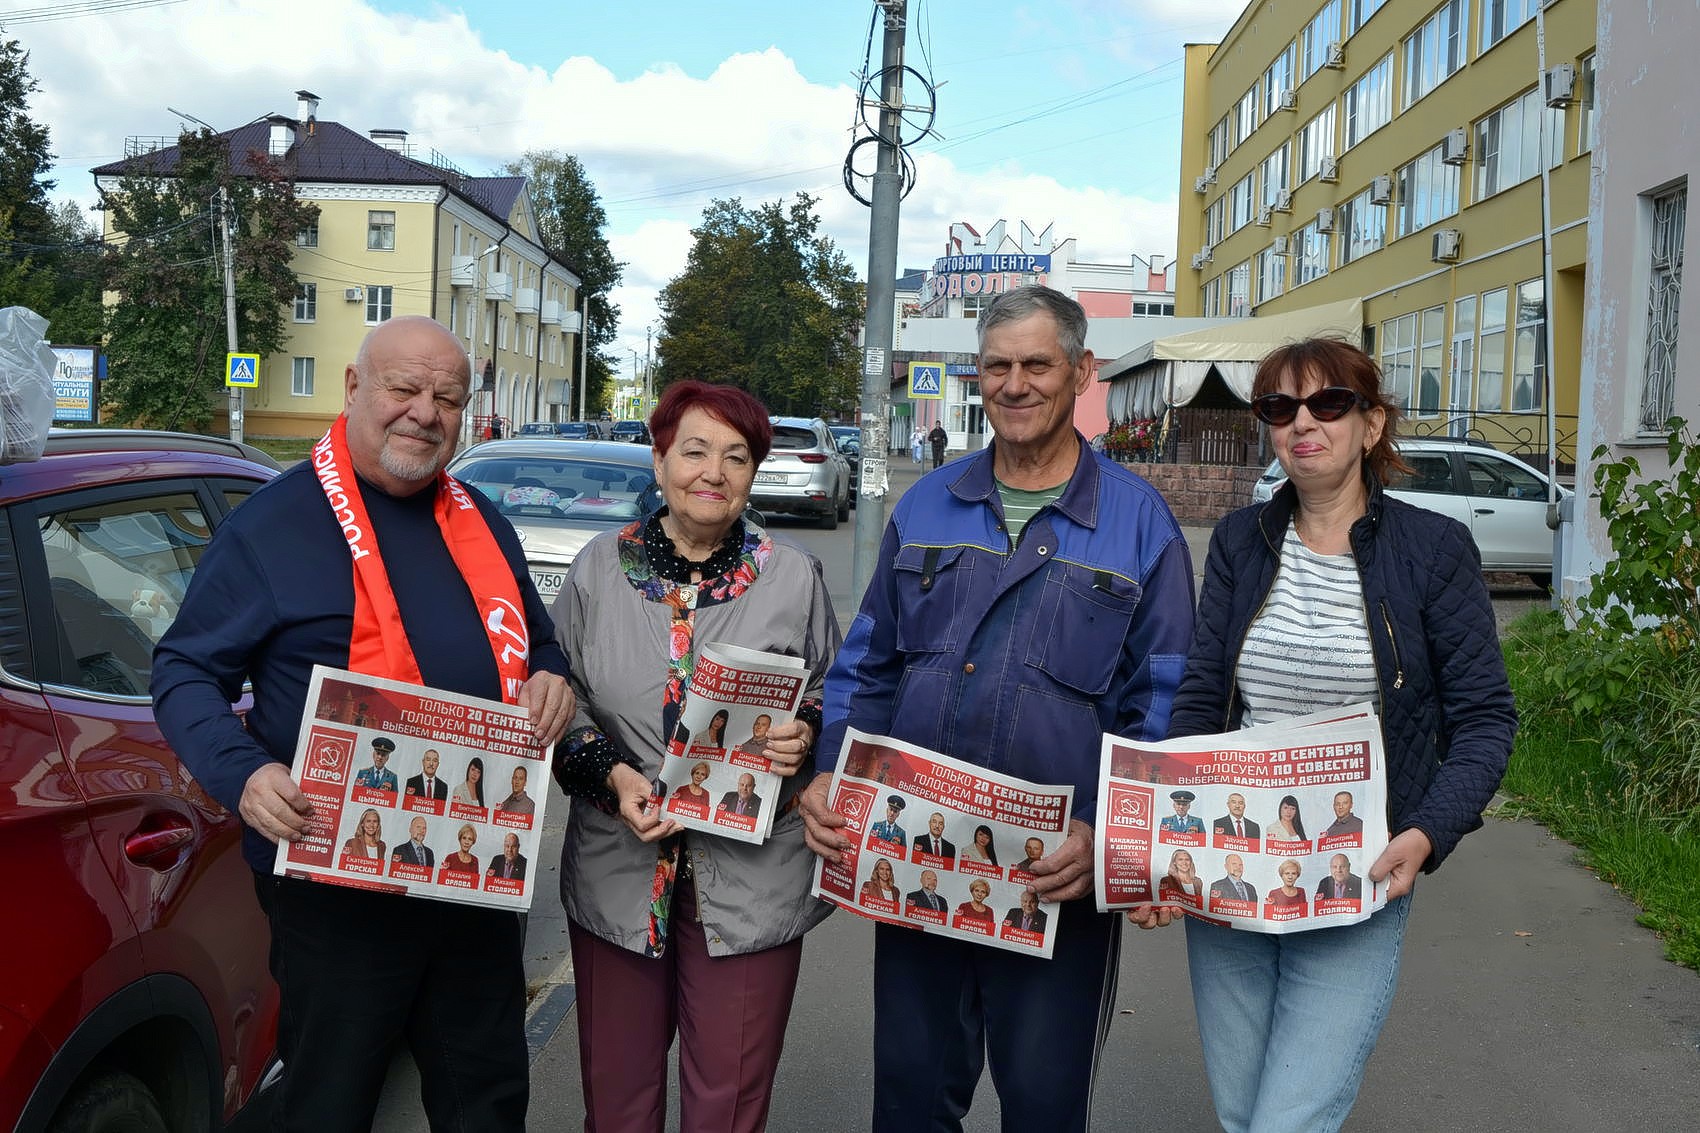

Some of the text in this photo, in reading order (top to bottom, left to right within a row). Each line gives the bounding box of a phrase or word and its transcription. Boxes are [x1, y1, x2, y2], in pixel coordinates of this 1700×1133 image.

[991, 255, 1035, 272] ЦЕНТР
[932, 268, 1047, 298] ОДОЛЕ
[536, 574, 561, 588] 750
[720, 668, 737, 680] 20
[739, 672, 797, 688] СЕНТЯБРЯ
[720, 682, 737, 692] ПО
[738, 683, 793, 699] СОВЕСТИ!
[735, 696, 789, 709] ДЕПУТАТОВ!
[418, 698, 536, 732] ТОЛЬКО 20 СЕНТЯБ
[400, 709, 465, 732] ГОЛОСУЕМ
[468, 724, 485, 737] ПО
[382, 720, 540, 759] ВЫБЕРЕМ НАРОДНЫХ ДЕПУТАТОВ!
[1212, 743, 1364, 764] ТОЛЬКО 20 СЕНТЯБРЯ
[1196, 757, 1364, 776] ГОЛОСУЕМ ПО СОВЕСТИ!
[309, 767, 342, 781] КПРФ
[1178, 771, 1364, 788] ВЫБЕРЕМ НАРОДНЫХ ДЕПУТАТОВ!
[931, 763, 1061, 807] ТОЛЬКО 20 СЕНТЯБРЯ
[914, 772, 1060, 820] ГОЛОСУЕМ ПО СОВЕСТИ!
[898, 780, 1058, 831] ВЫБЕРЕМ НАРОДНЫХ ДЕПУТАТОВ!
[450, 811, 486, 822] БОГДАНОВА
[674, 808, 701, 818] ОРЛОВА
[845, 817, 860, 829] РФ
[1114, 816, 1146, 826] КПРФ
[295, 842, 304, 850] ОТ
[300, 834, 332, 846] ОЛОМНА
[1110, 837, 1148, 845] КАНДИДАТЫ
[960, 867, 1000, 880] БОГДАНОВА
[1016, 871, 1036, 880] Дмит
[445, 878, 471, 888] ОРЛОВА
[1272, 912, 1300, 920] ОРЛОВА
[960, 924, 987, 934] ОРЛОВА
